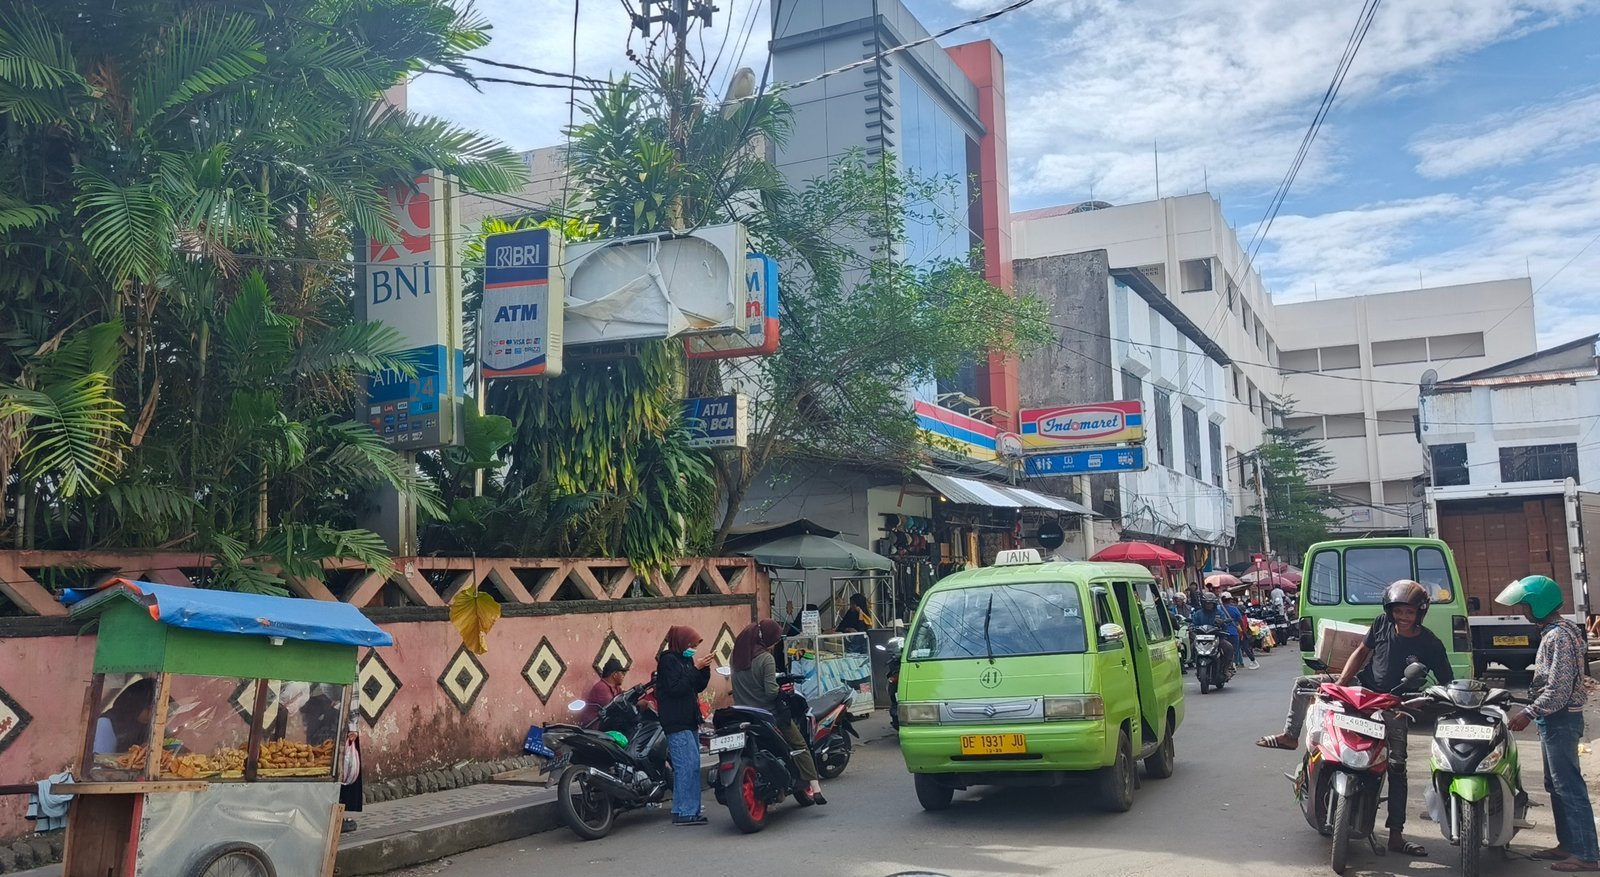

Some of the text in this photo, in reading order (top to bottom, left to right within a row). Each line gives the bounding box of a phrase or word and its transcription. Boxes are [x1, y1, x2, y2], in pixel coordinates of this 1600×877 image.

[512, 244, 540, 266] BRI
[372, 260, 431, 305] BNI
[494, 303, 538, 323] ATM
[372, 366, 434, 402] ATM 24
[701, 402, 729, 417] ATM
[709, 416, 734, 431] BCA
[1043, 414, 1118, 433] Indomaret
[981, 671, 998, 684] 41
[962, 733, 1024, 748] DE 1931 JU
